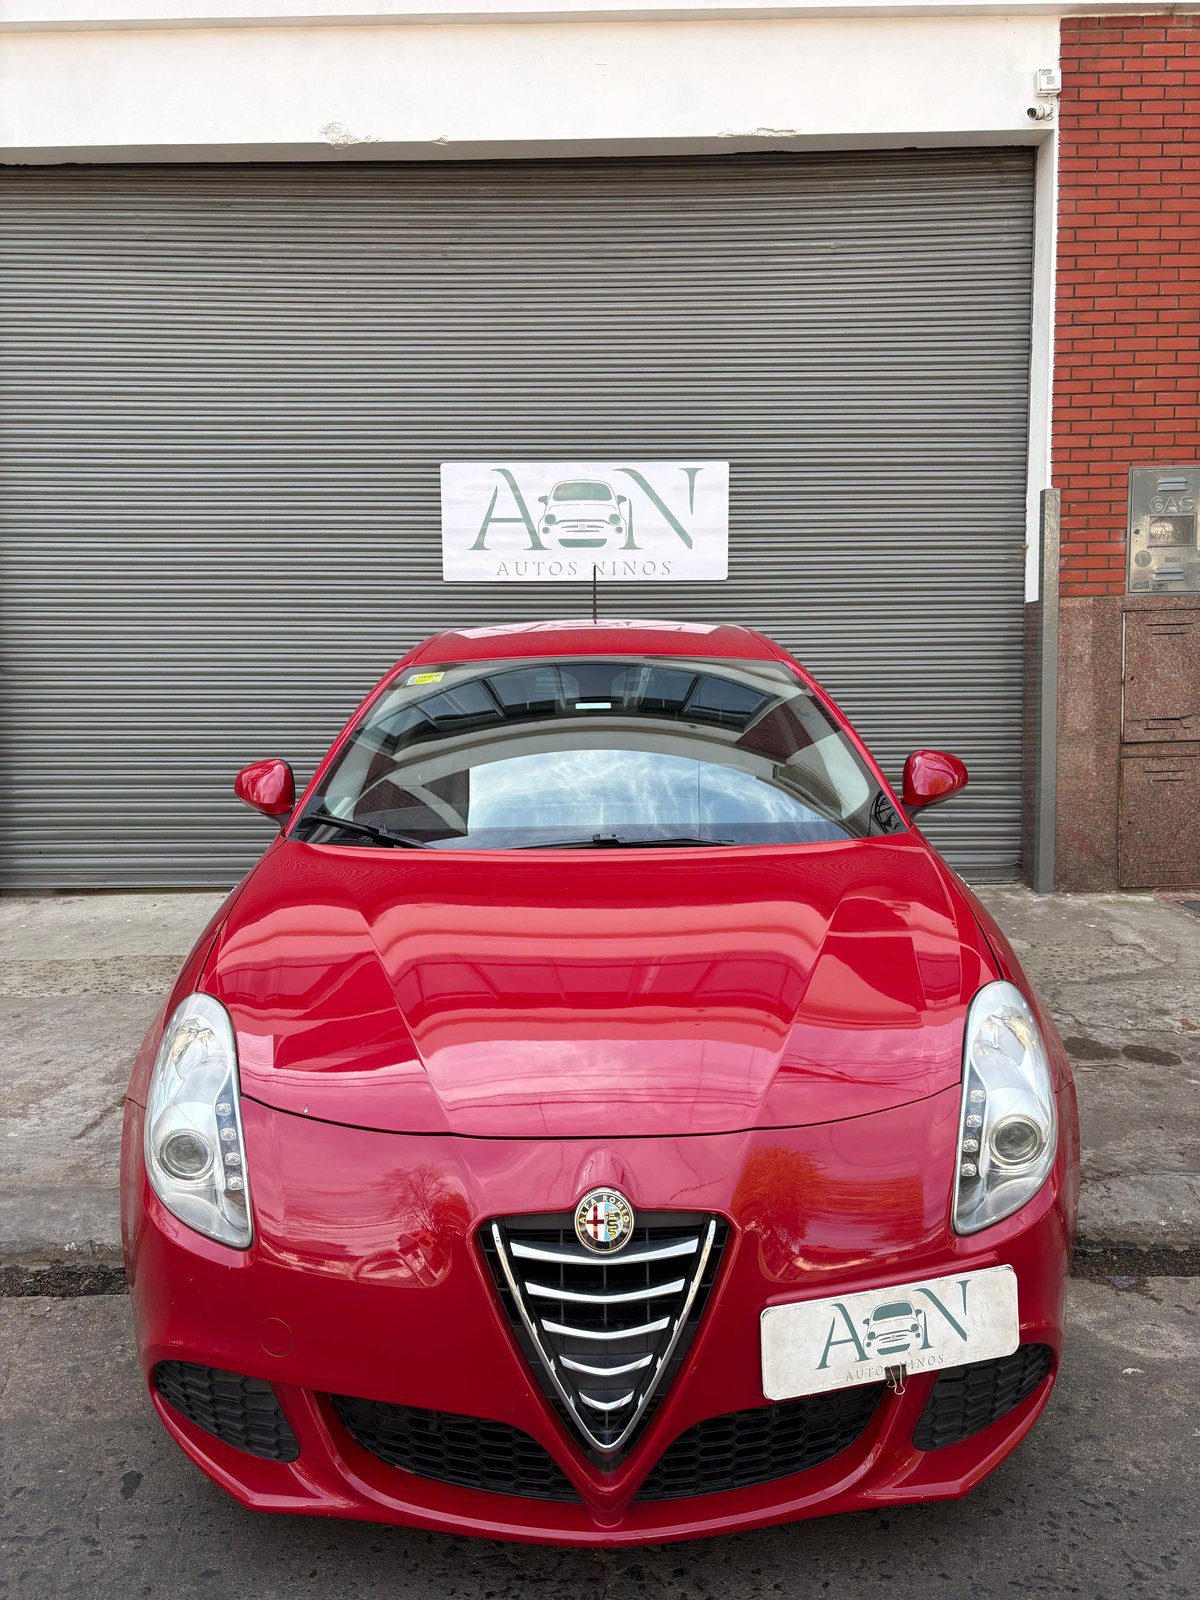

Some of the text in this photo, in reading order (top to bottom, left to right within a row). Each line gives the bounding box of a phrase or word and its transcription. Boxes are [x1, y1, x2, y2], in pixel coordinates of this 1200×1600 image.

[1150, 495, 1194, 514] GAS
[496, 560, 672, 576] AUTOS NINOS
[579, 1195, 630, 1224] ALFA ROMEO
[846, 1363, 892, 1382] AUTO
